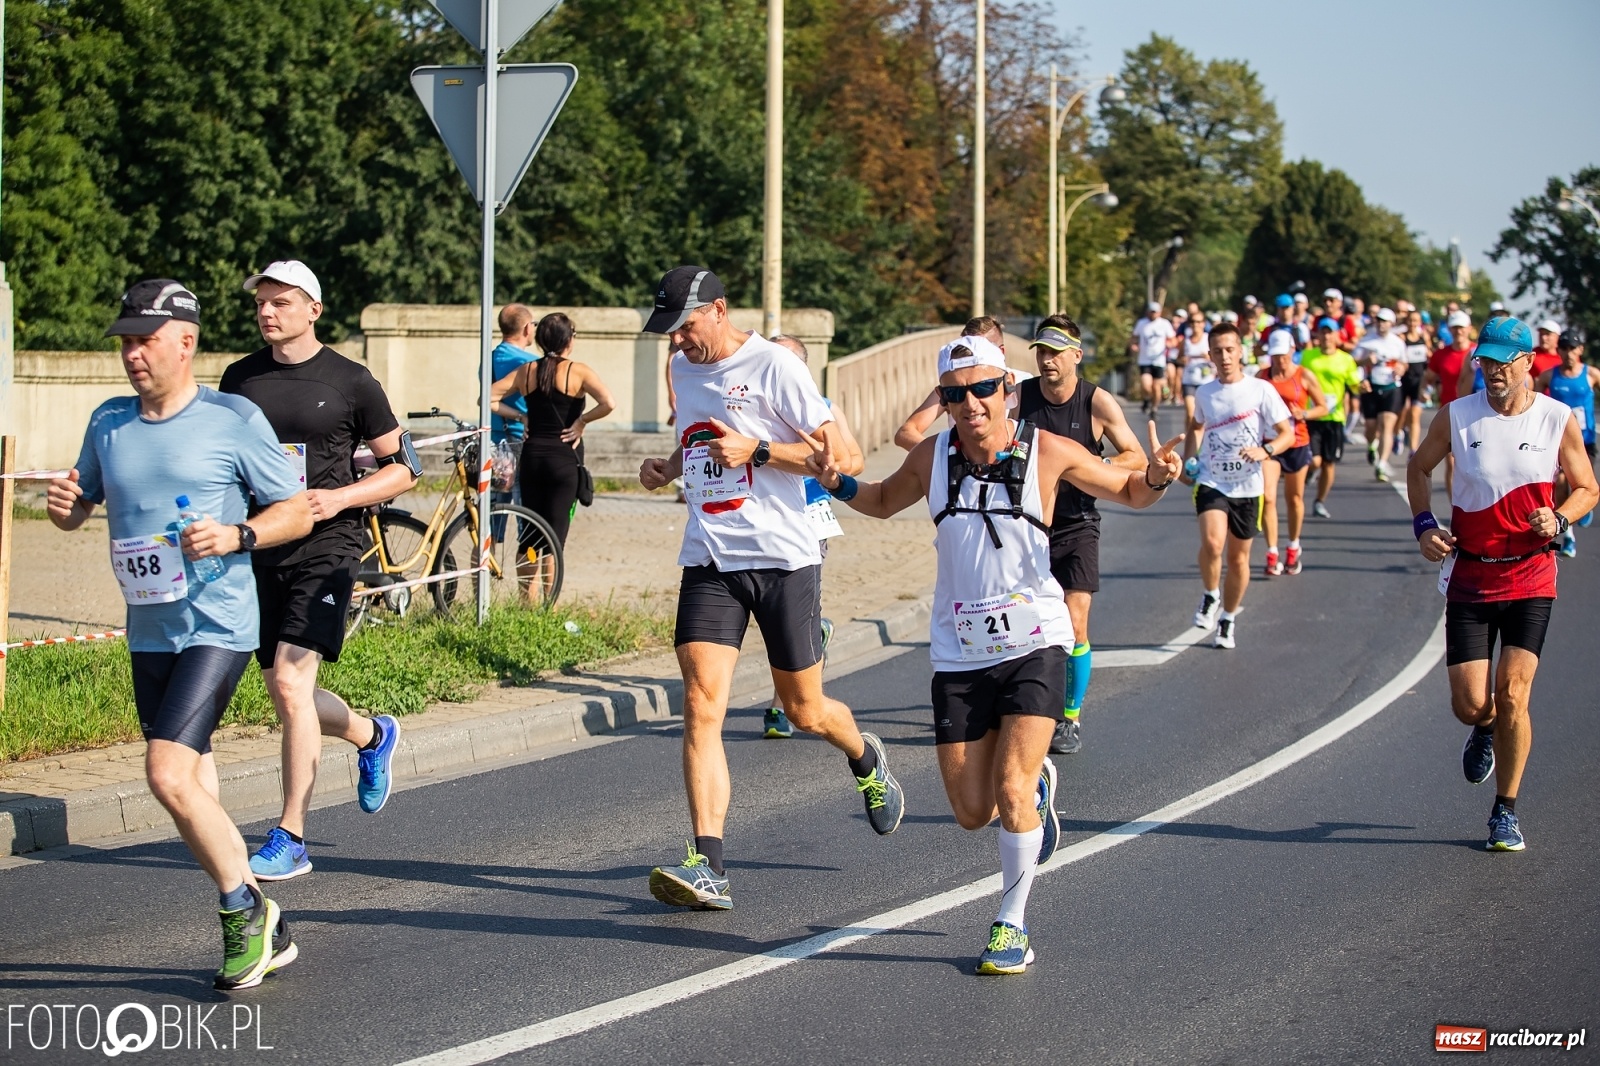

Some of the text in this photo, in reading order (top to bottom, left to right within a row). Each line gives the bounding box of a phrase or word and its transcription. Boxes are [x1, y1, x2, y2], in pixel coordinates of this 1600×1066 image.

[1470, 441, 1482, 449] 4F
[703, 461, 723, 480] 40
[1222, 461, 1242, 472] 230
[127, 554, 162, 579] 458
[984, 612, 1011, 635] 21
